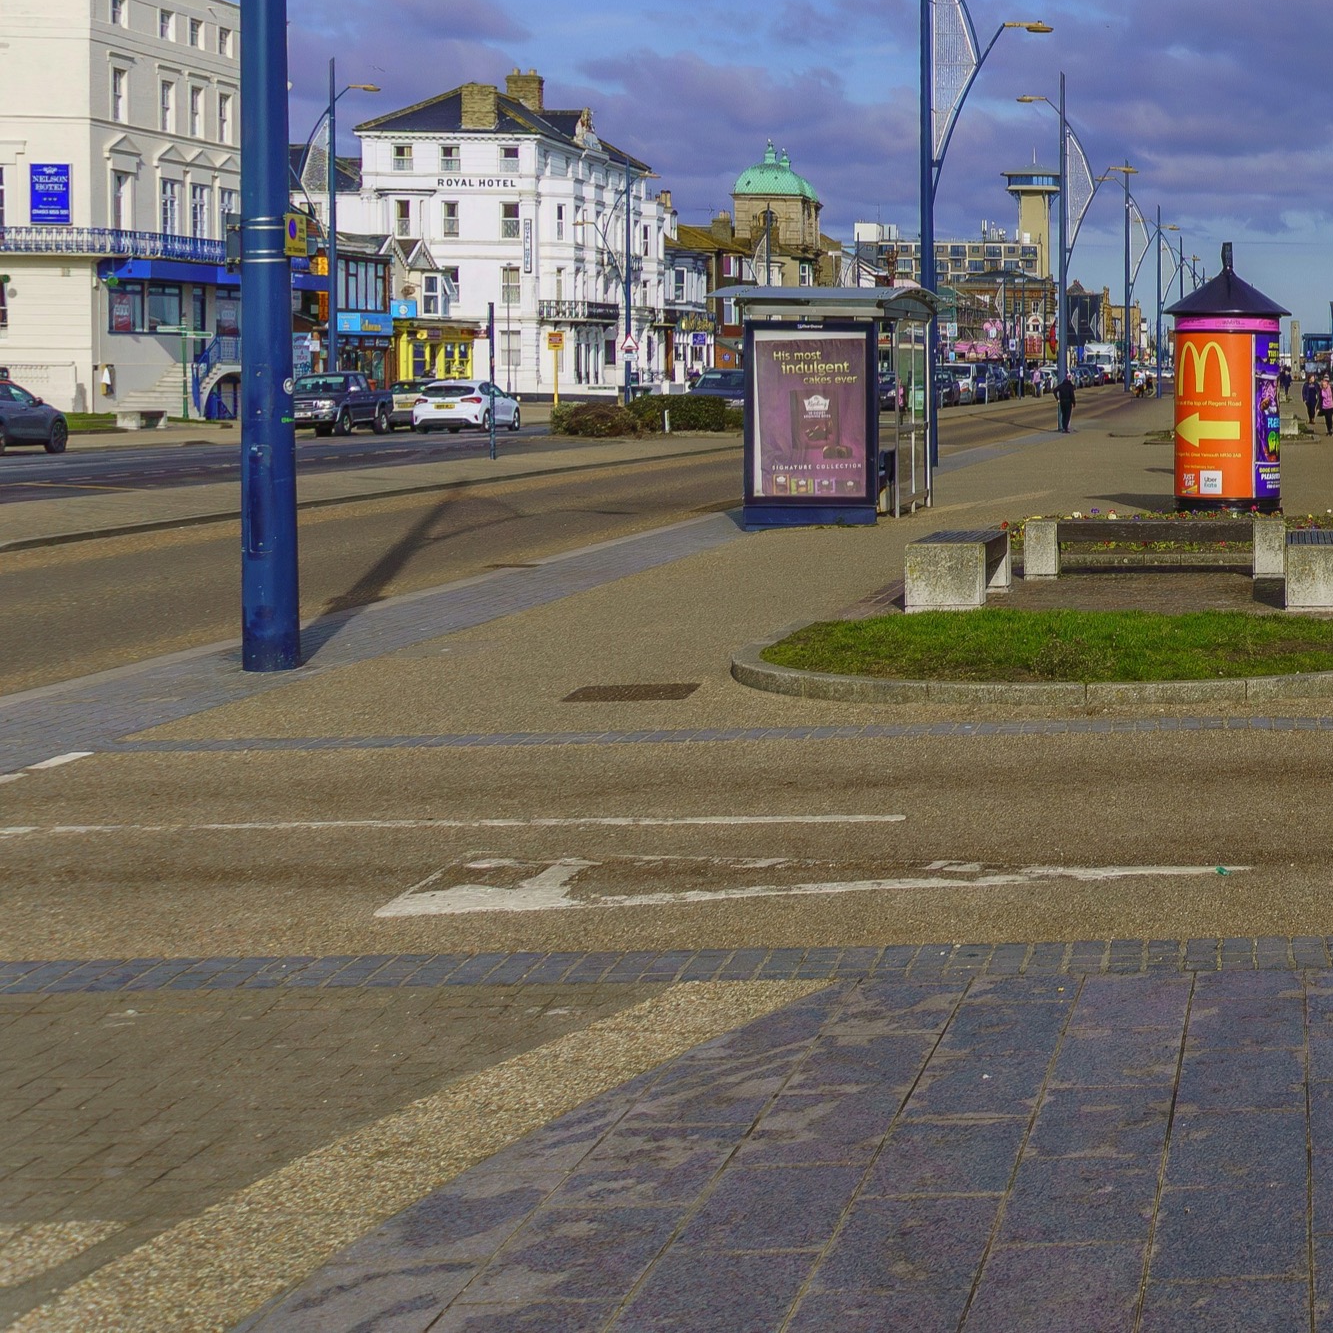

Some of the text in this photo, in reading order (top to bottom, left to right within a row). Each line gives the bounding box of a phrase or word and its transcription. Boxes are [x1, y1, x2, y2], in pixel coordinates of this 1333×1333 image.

[438, 179, 516, 187] ROYAL HOTEL
[773, 351, 822, 361] His most
[781, 361, 850, 376] indulgent
[803, 375, 858, 384] cakes ever
